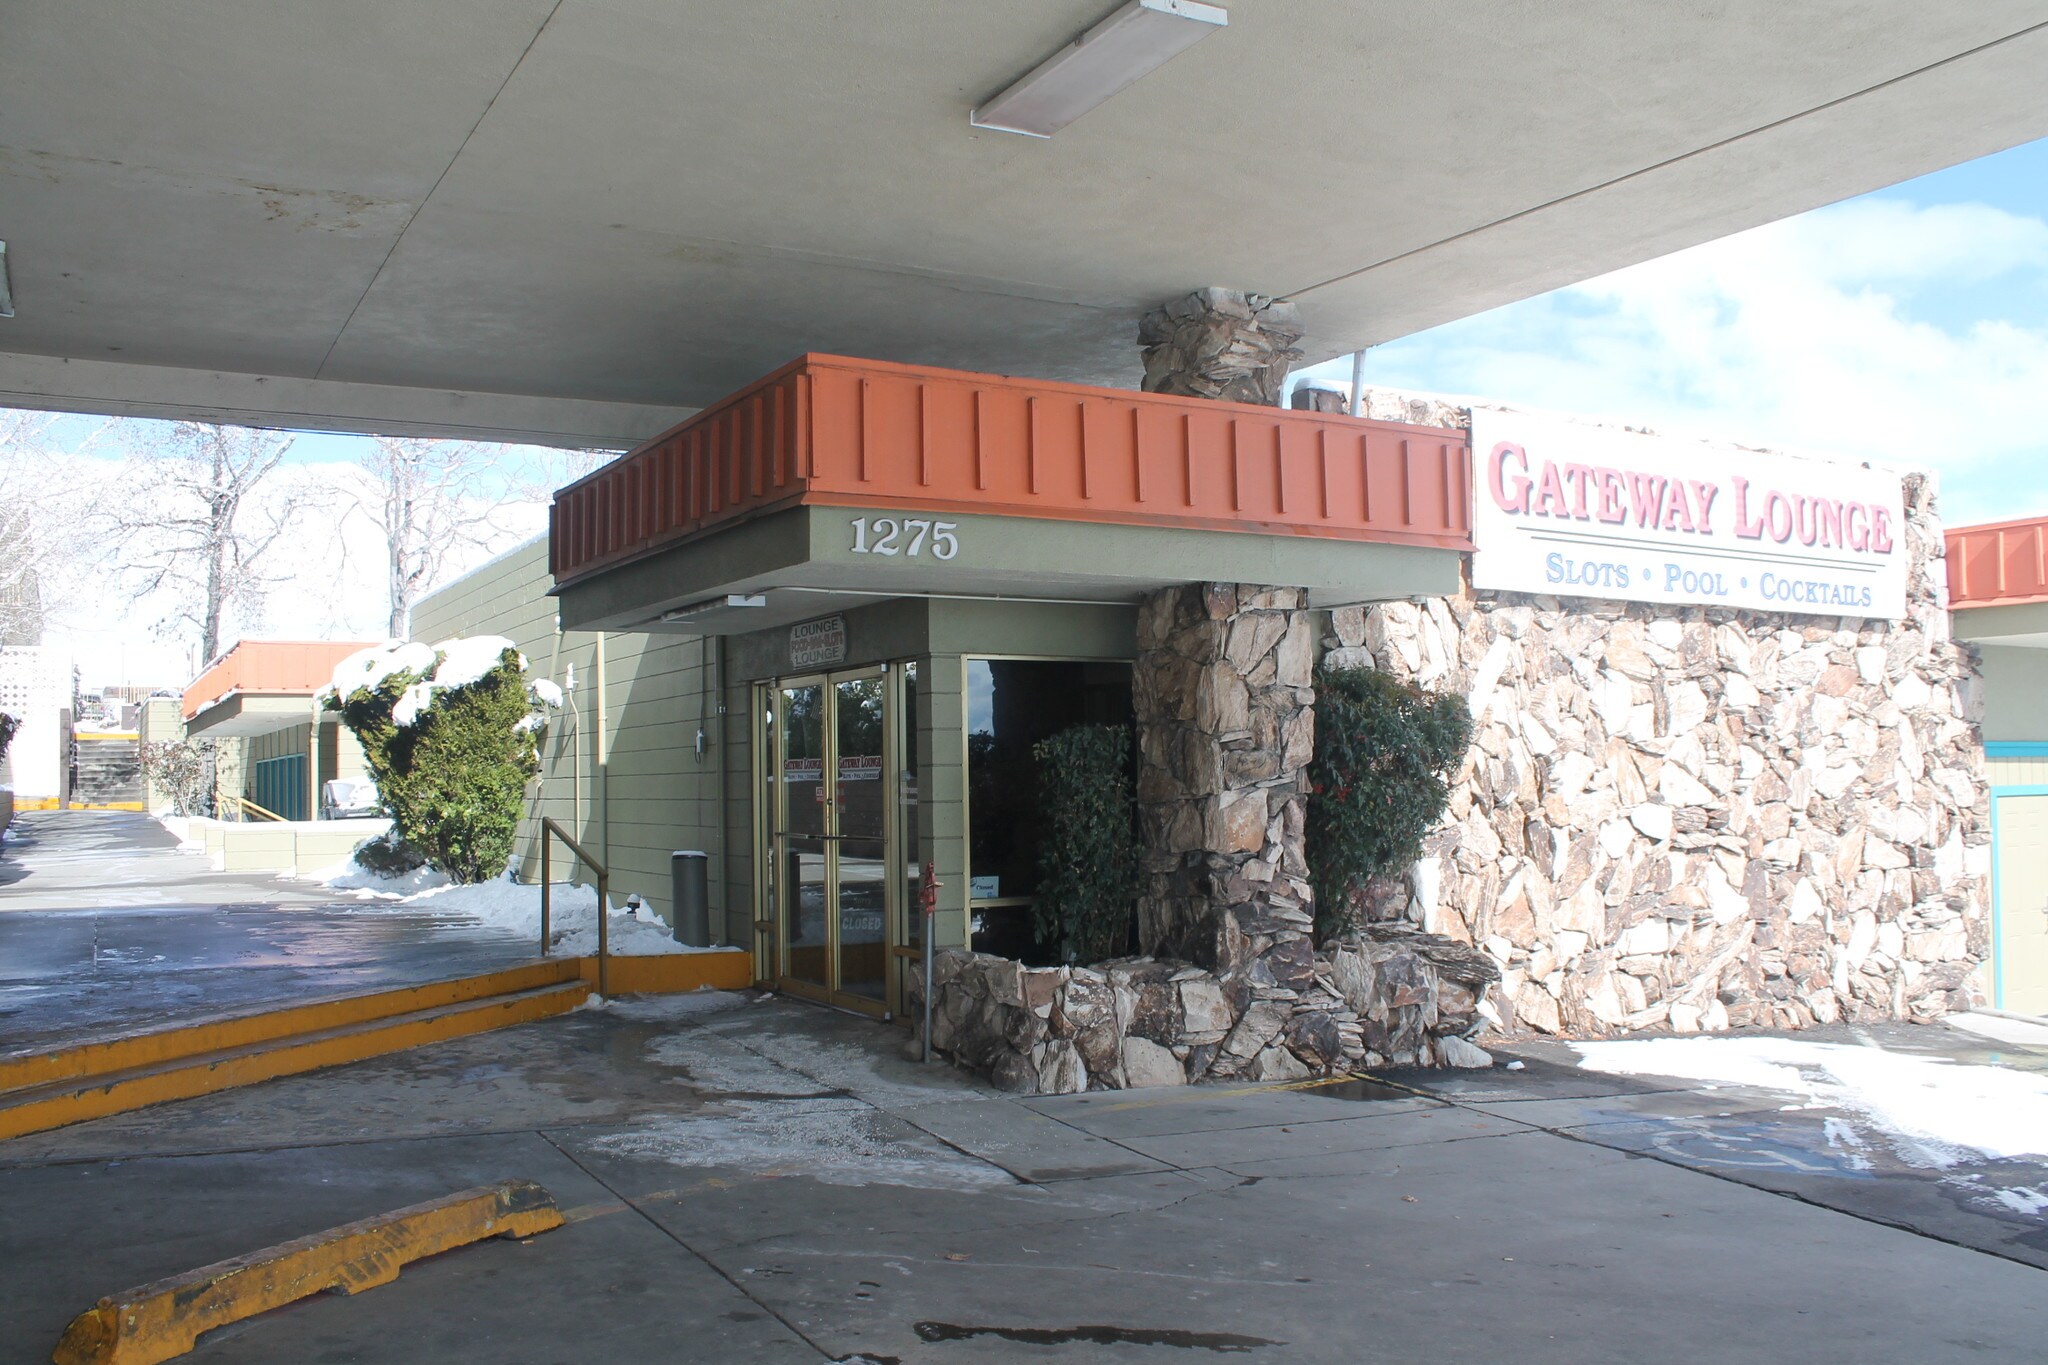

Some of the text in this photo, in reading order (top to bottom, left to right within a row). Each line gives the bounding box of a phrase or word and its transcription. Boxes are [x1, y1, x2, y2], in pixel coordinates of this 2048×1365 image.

[1488, 441, 1894, 553] GATEWAY LOUNGE
[850, 518, 959, 560] 1275
[1546, 552, 1872, 607] SLOTS POOL COCKTAILS
[794, 618, 839, 639] LOUNGE
[794, 646, 839, 665] LOUNGE
[842, 917, 881, 930] CLOSED
